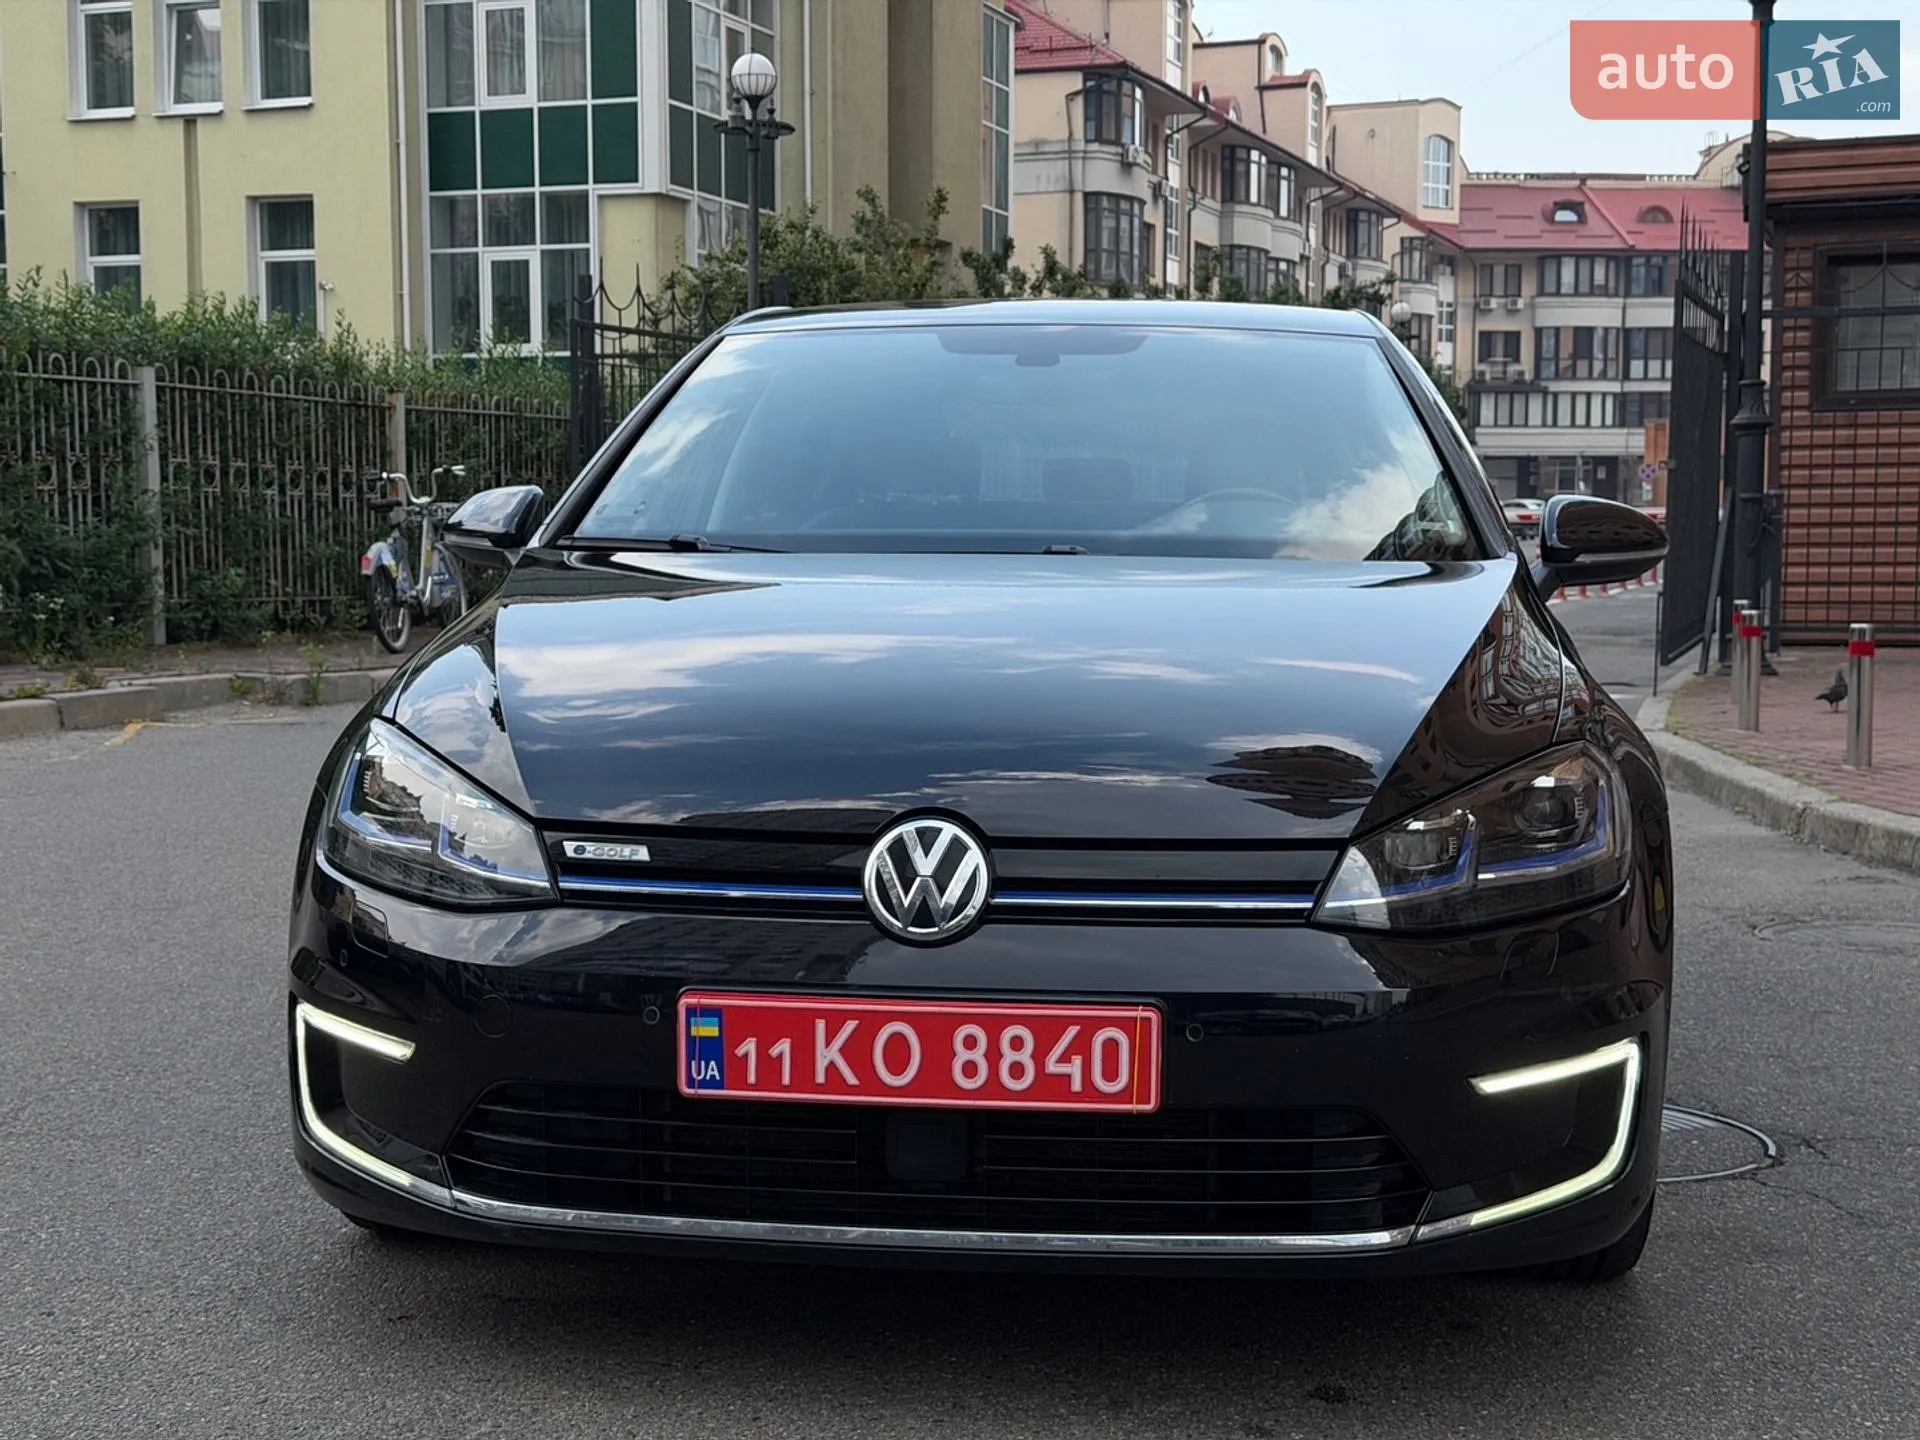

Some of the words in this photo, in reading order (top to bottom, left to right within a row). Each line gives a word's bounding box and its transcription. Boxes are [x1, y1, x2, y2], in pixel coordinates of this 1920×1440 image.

[691, 1060, 720, 1081] UA
[734, 1037, 791, 1086] 11
[815, 1018, 921, 1087] KO
[951, 1024, 1130, 1094] 8840
